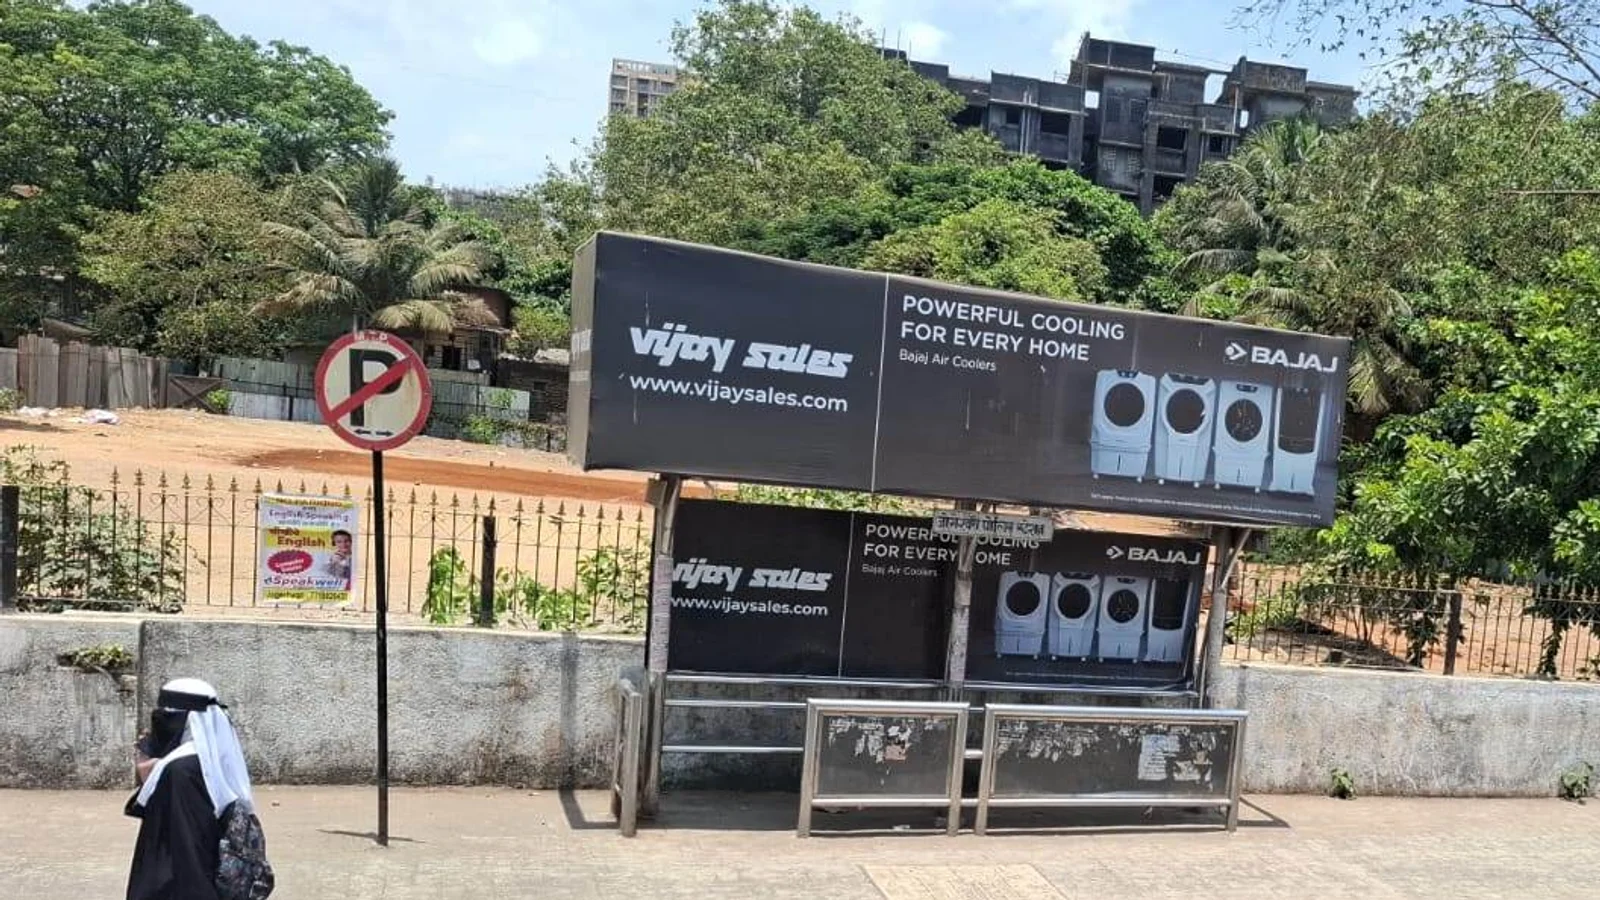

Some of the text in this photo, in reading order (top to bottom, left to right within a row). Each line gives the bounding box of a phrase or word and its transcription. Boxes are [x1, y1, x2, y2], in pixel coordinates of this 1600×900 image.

[903, 295, 1125, 340] POWERFUL COOLING
[630, 323, 735, 373] vijay
[742, 343, 853, 378] sales
[901, 321, 1090, 361] FOR EVERY HOME
[900, 349, 996, 371] Bajaj Air Coolers
[1251, 346, 1338, 372] BAJAJ
[630, 375, 848, 412] www.vijaysales.com
[277, 535, 326, 548] English
[977, 534, 1040, 549] OOLING
[863, 542, 1012, 565] FOR EVERY OME
[1128, 547, 1200, 565] BAJAJ
[748, 568, 833, 592] sales
[887, 565, 901, 575] Air
